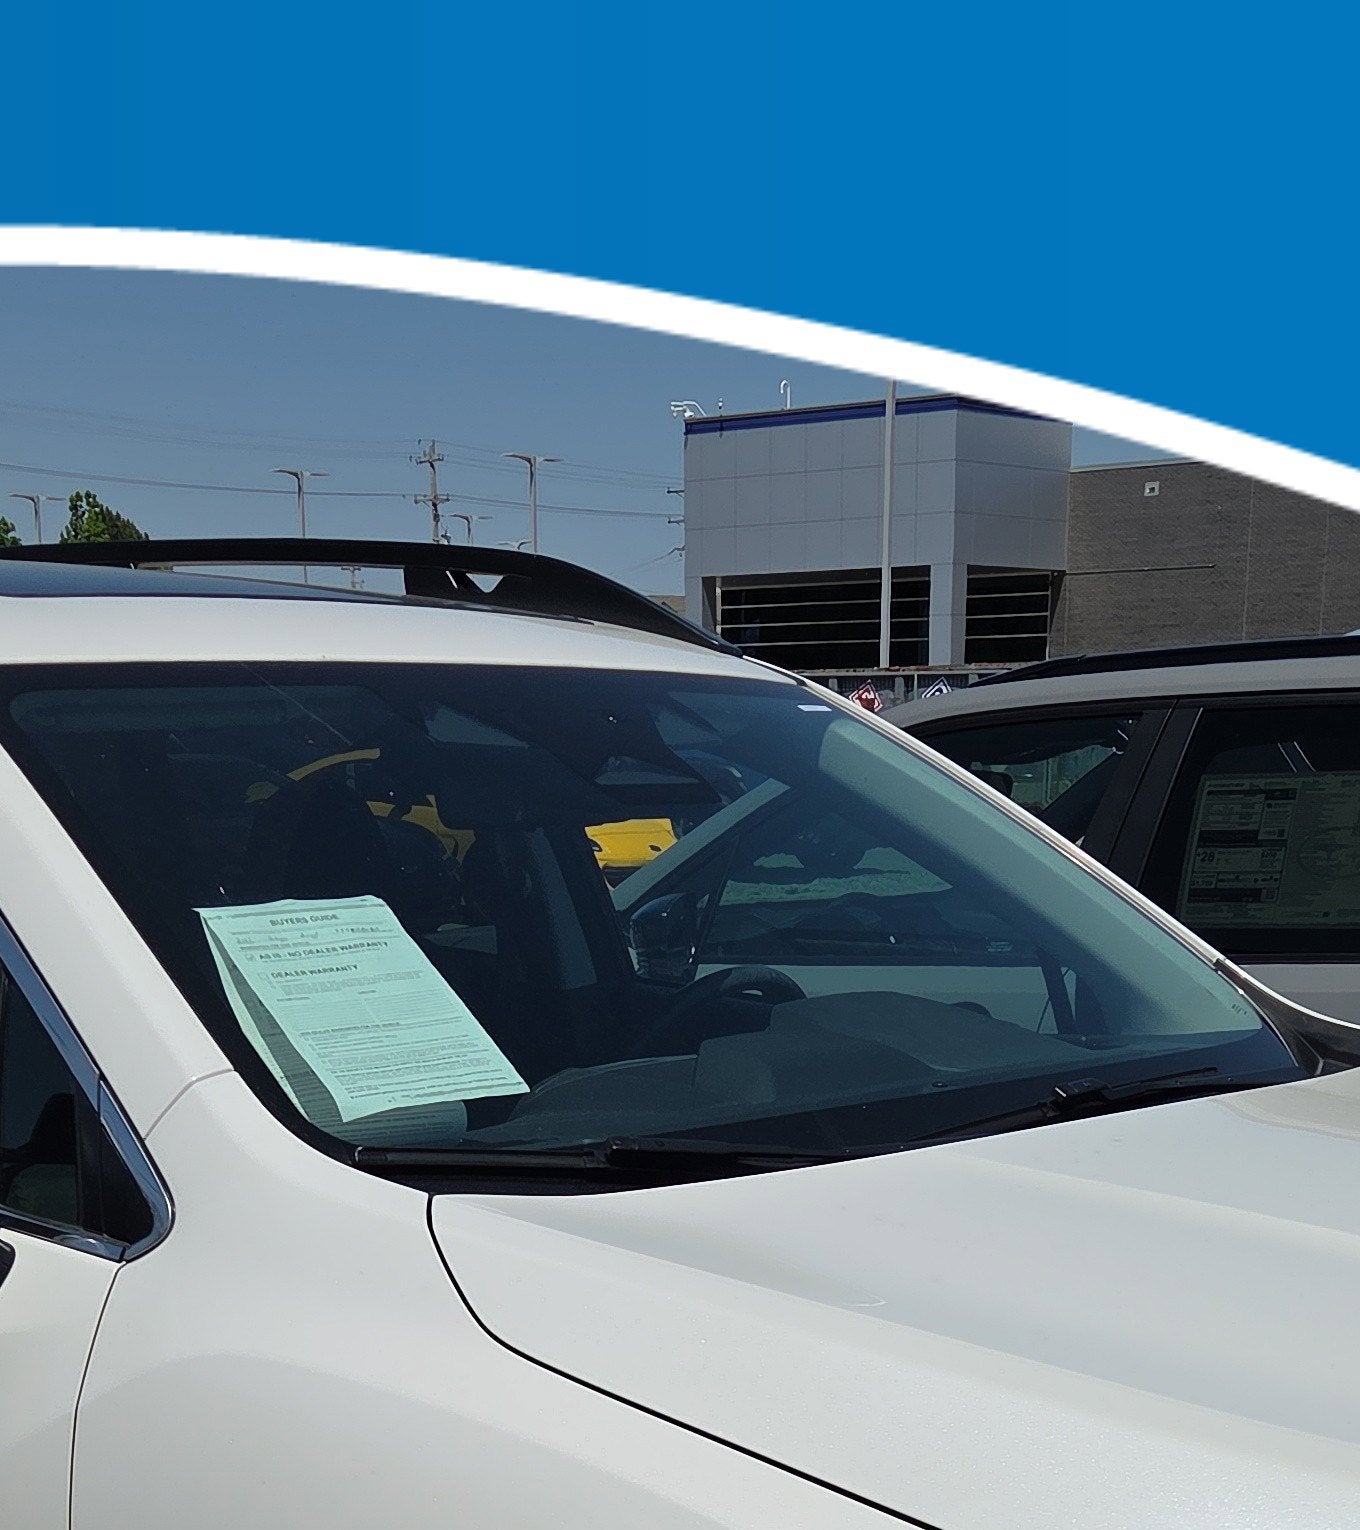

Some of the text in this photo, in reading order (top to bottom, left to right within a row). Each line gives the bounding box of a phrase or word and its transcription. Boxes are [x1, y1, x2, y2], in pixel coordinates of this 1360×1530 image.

[269, 913, 339, 927] BUYERS GUIDE
[302, 946, 339, 956] DEALER
[339, 941, 388, 951] WARRANTY
[270, 963, 358, 979] DEALER WARRANTY
